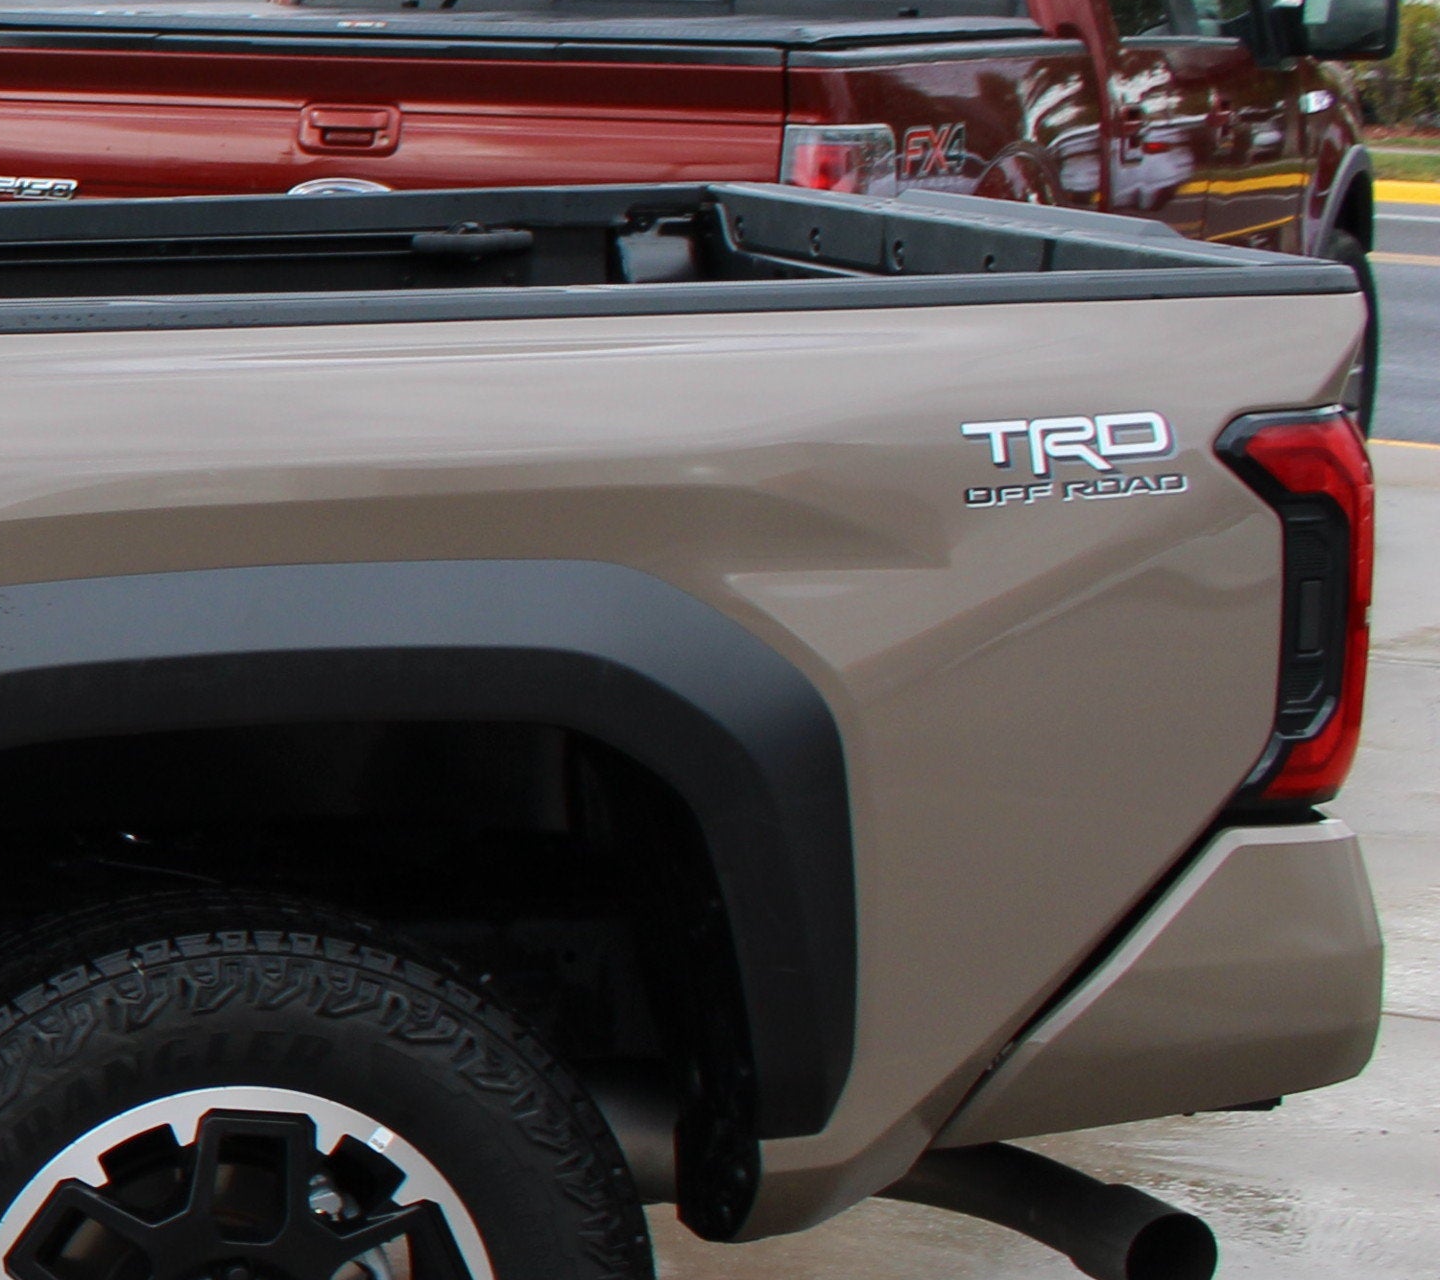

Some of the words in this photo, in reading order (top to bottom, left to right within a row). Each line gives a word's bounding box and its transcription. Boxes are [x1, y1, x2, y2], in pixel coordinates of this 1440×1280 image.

[901, 122, 967, 178] FX4
[960, 410, 1177, 479] TRD
[963, 483, 1055, 509] OFF
[1061, 473, 1189, 503] ROAD
